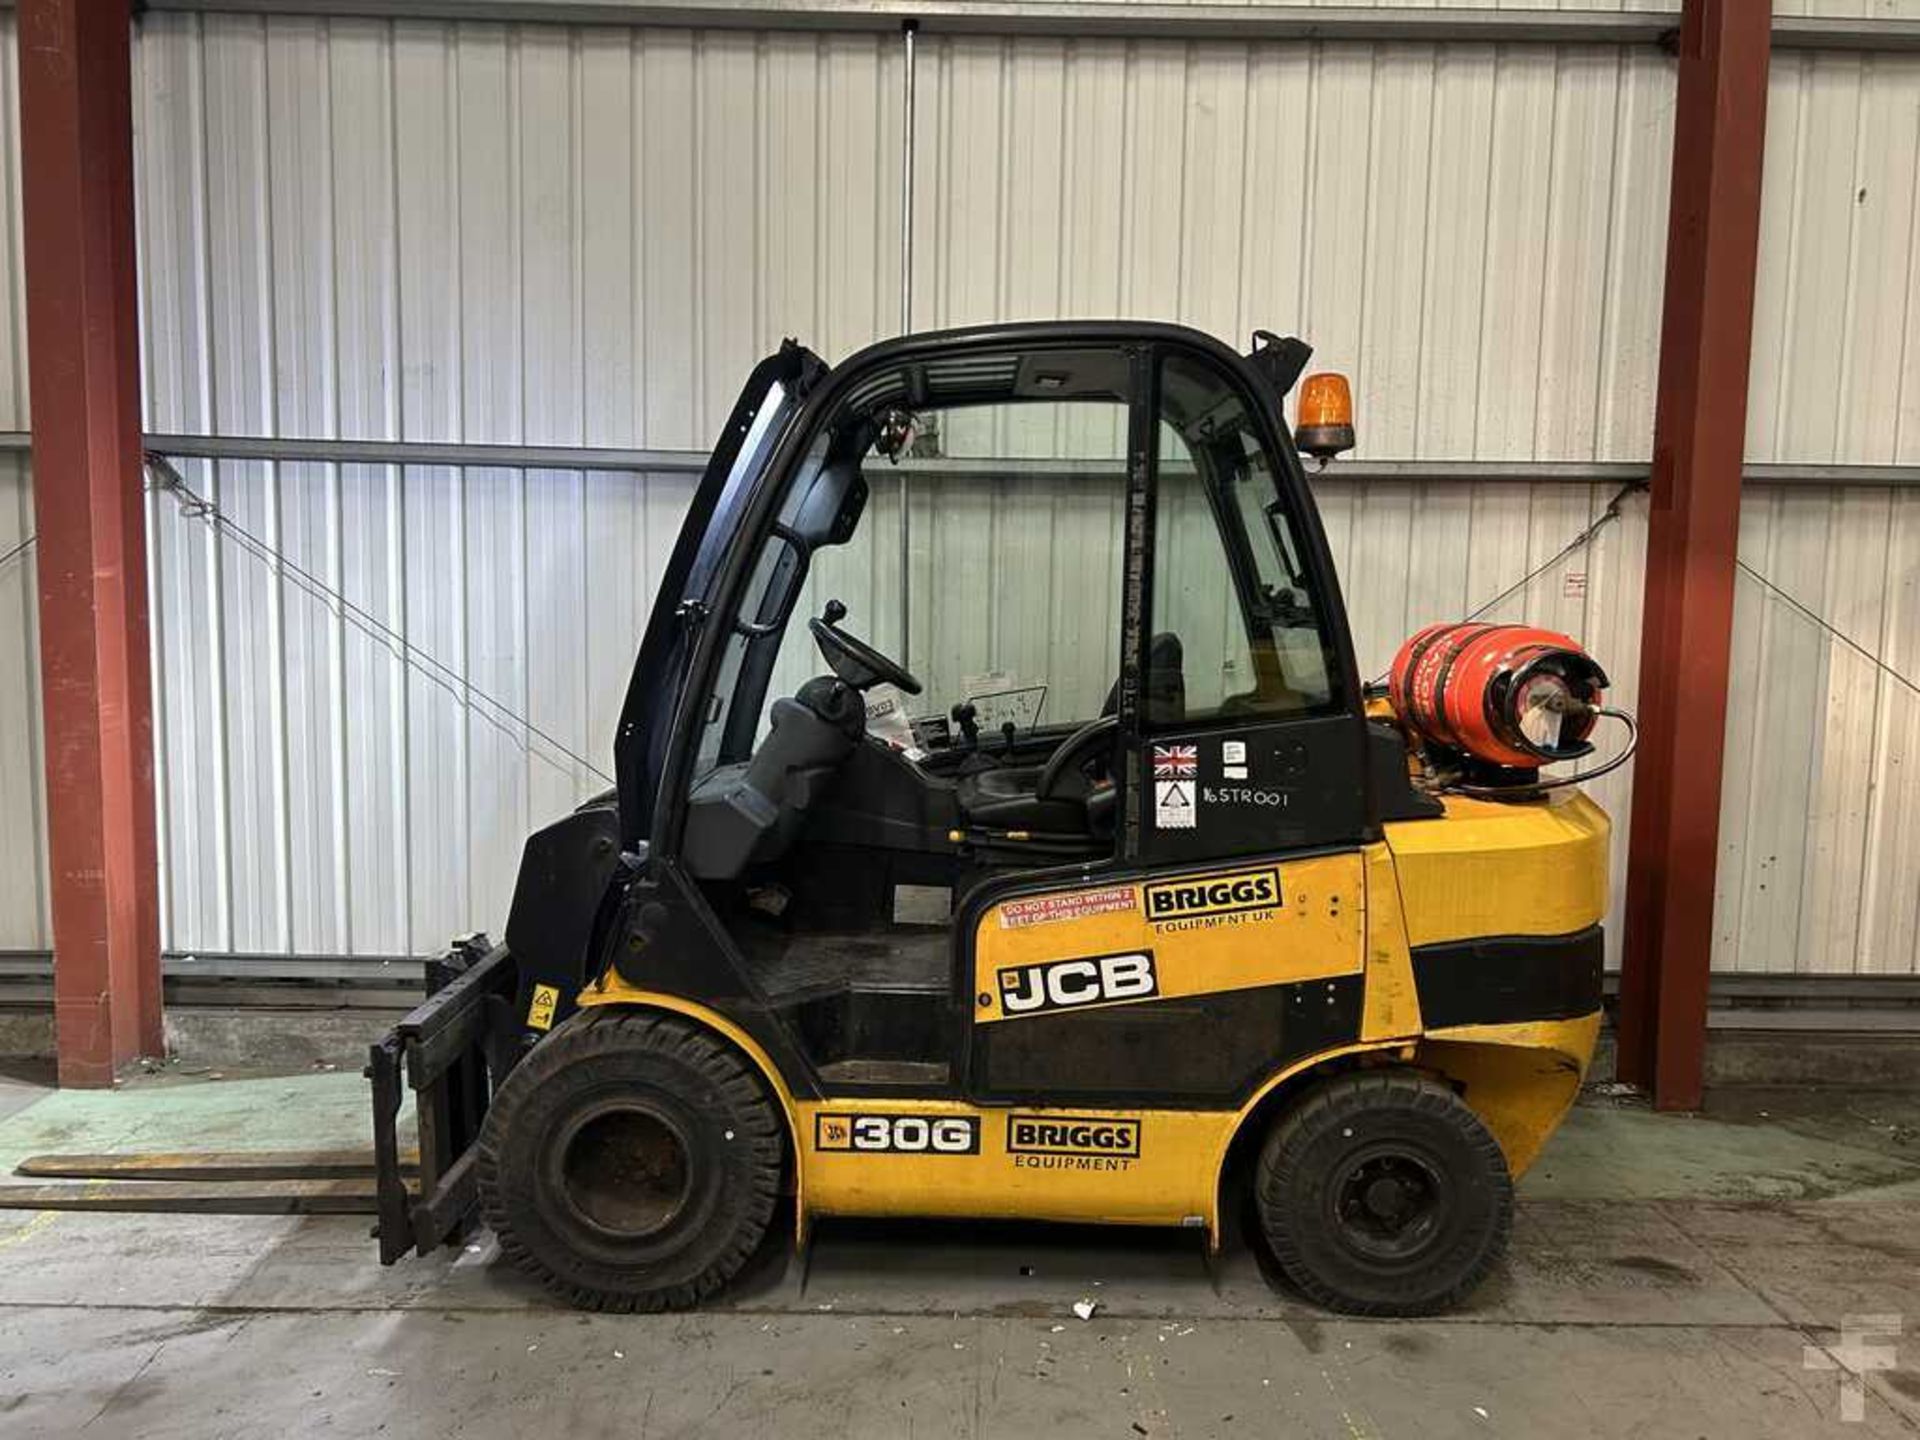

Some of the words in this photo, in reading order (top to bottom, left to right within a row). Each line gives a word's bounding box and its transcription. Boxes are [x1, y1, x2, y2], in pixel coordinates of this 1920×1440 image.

[1024, 901, 1046, 913] NOT
[1049, 897, 1083, 909] STAND
[1085, 891, 1121, 904] WITHIN
[1152, 878, 1272, 912] BRIGGS
[1074, 900, 1135, 916] EQUIPMENT
[1155, 913, 1249, 935] EQUIPMENT
[1252, 910, 1275, 922] UK
[1003, 954, 1154, 1011] JCB
[854, 1117, 972, 1151] 30G
[1016, 1124, 1131, 1148] BRIGGS
[1015, 1155, 1132, 1171] EQUIPMENT
